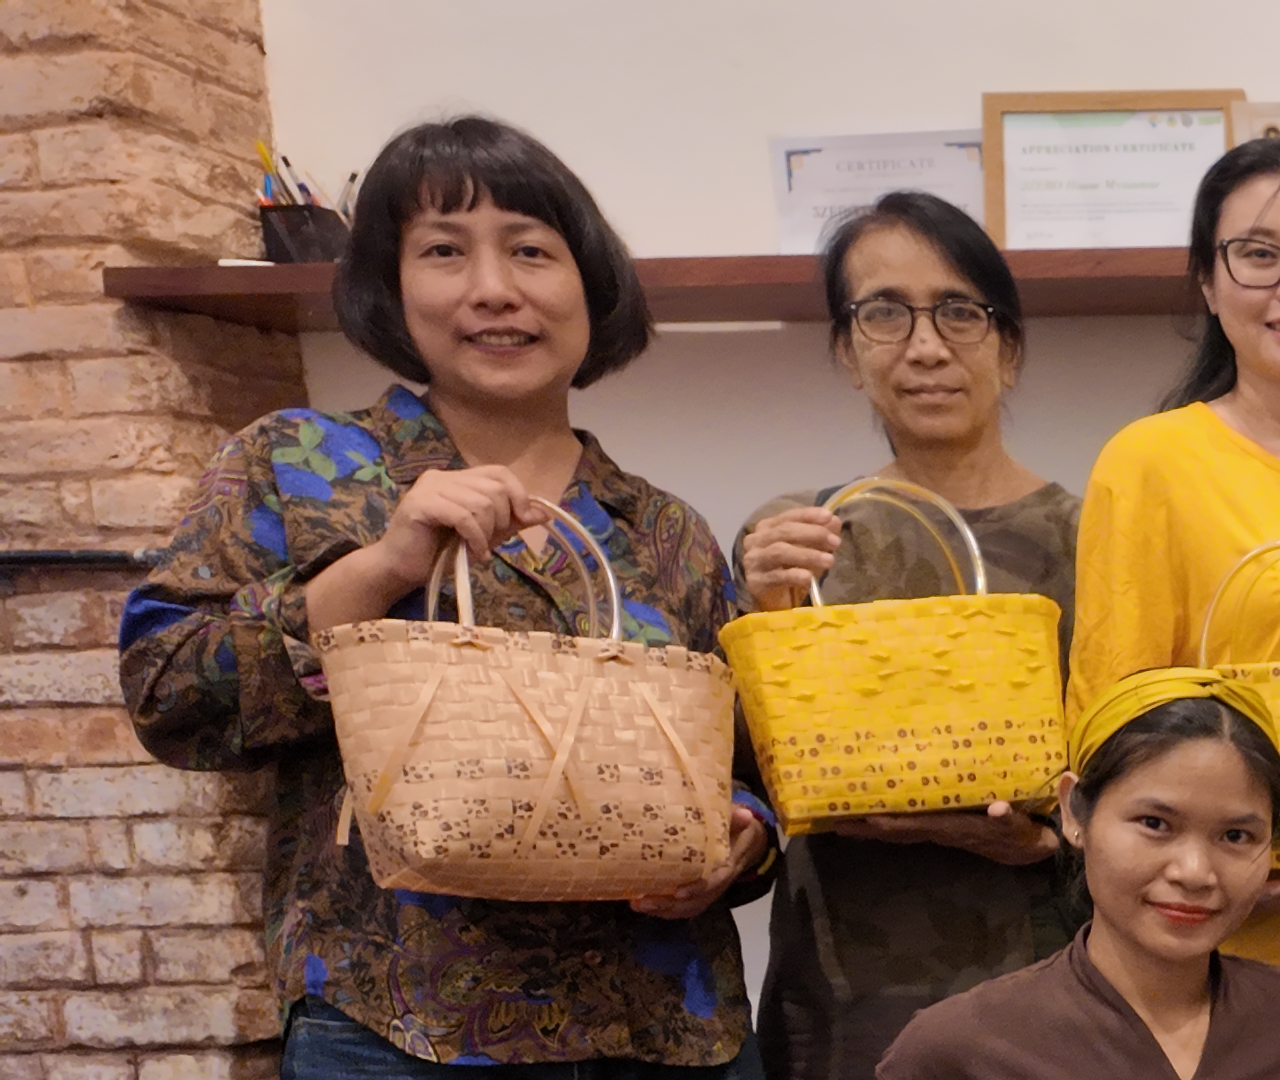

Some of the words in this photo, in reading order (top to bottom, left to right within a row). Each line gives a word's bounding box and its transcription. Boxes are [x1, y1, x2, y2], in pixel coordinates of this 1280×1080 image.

[1021, 144, 1110, 155] APPRECIATION
[1114, 142, 1196, 153] CERTIFICATE
[836, 157, 936, 172] CERTIFICATE
